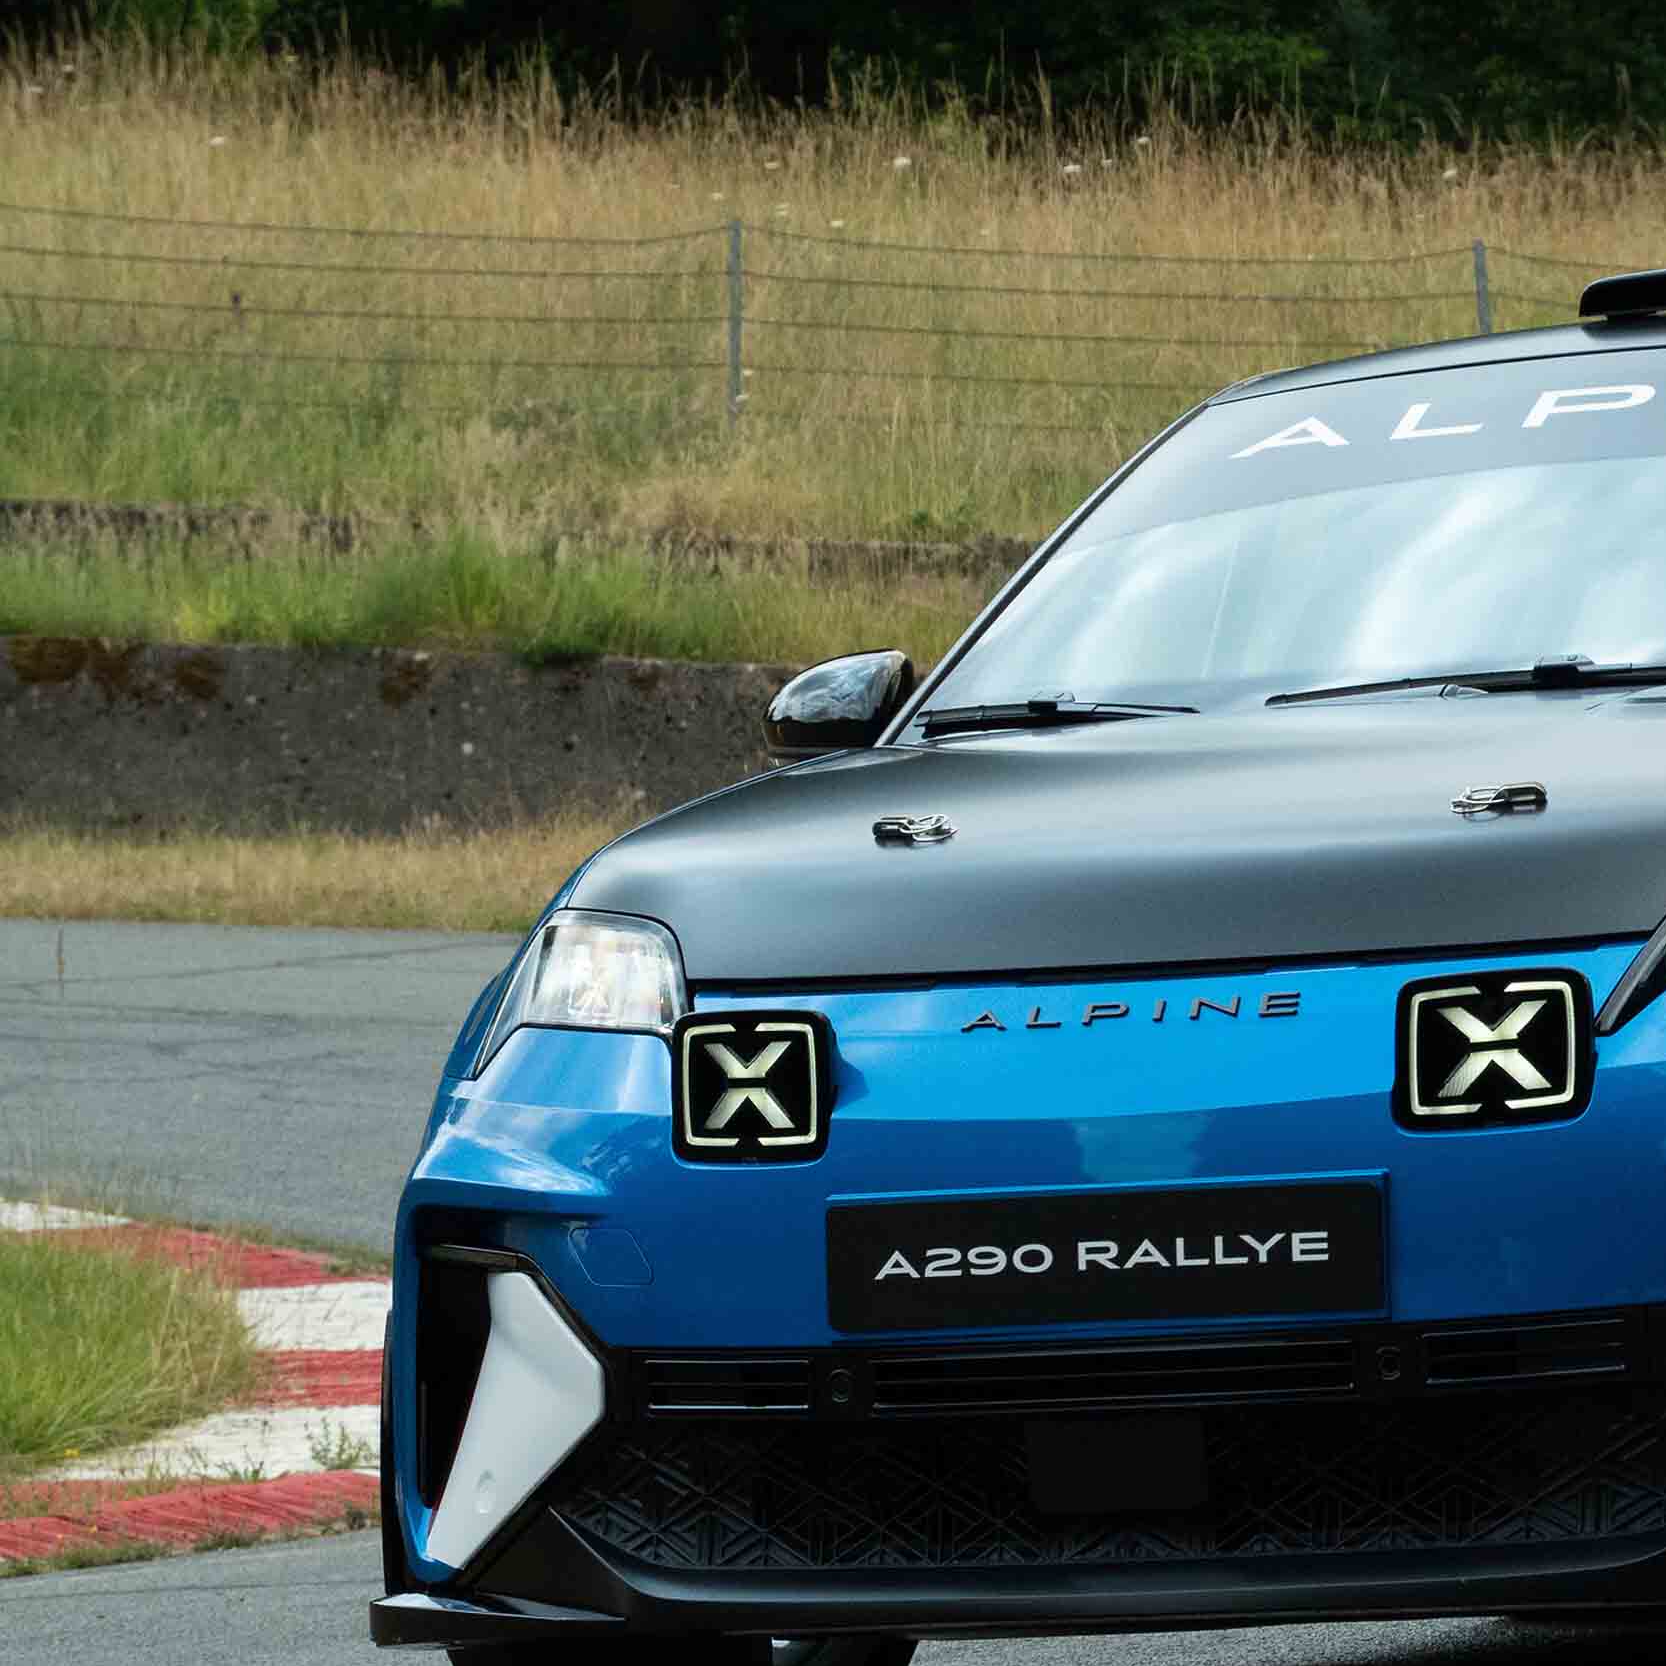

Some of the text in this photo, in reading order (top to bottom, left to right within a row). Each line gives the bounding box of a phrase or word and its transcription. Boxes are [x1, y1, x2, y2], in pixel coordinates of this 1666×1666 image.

[961, 991, 1301, 1033] ALPINE
[874, 1231, 1330, 1281] A290 RALLYE
